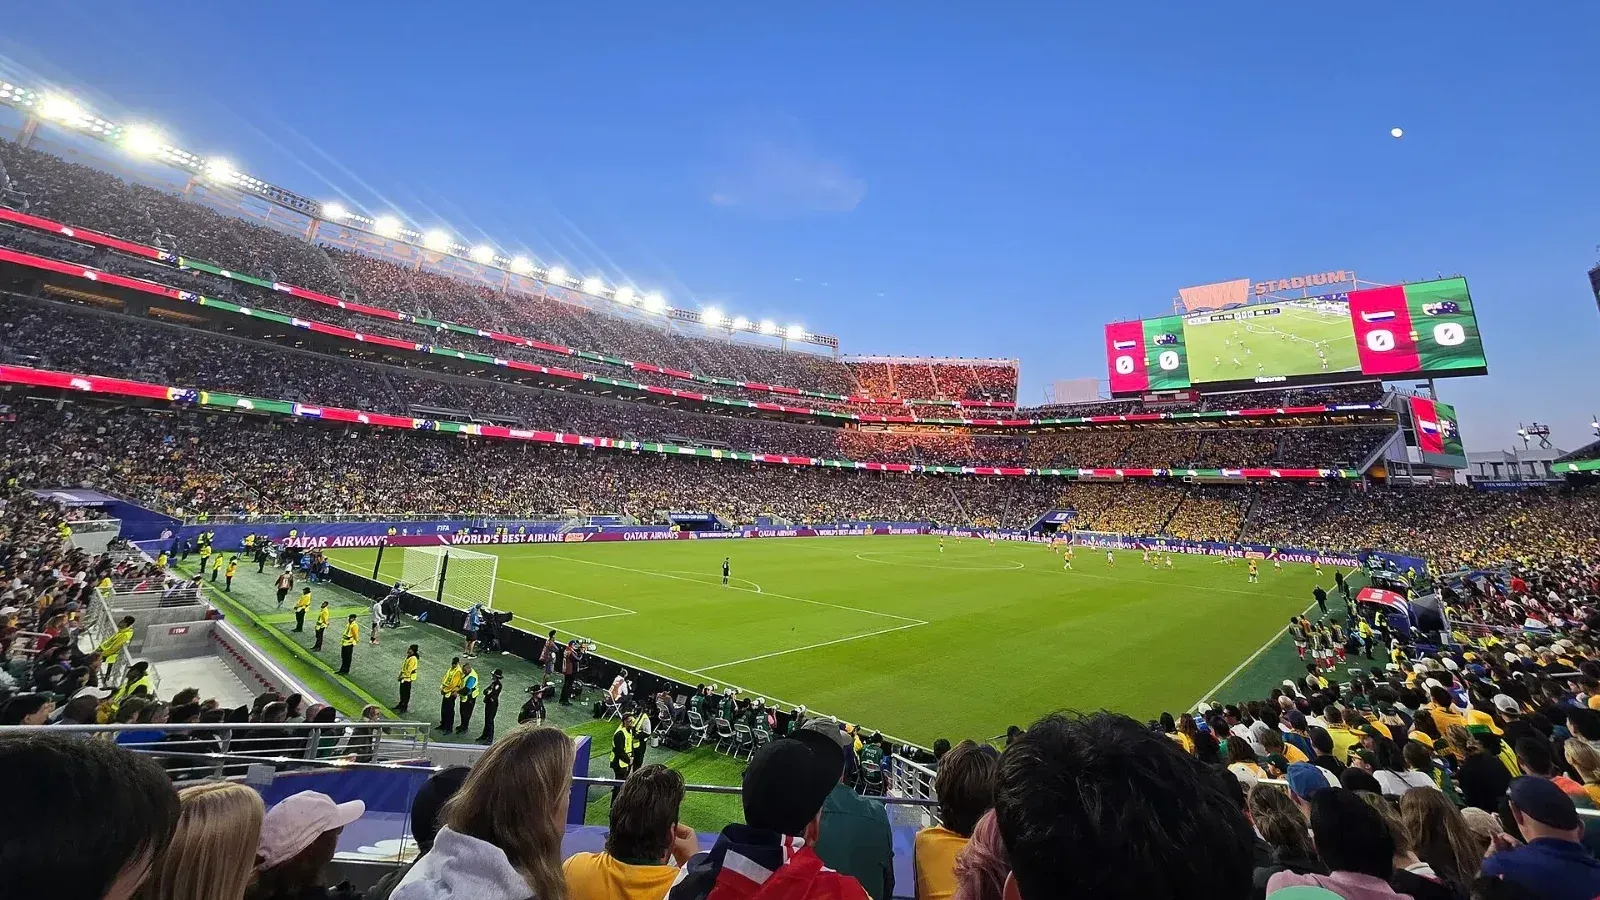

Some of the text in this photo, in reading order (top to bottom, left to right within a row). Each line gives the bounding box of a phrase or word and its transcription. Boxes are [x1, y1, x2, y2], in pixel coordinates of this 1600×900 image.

[1255, 270, 1346, 295] STADIUM
[451, 534, 500, 545] WORLD'S
[501, 533, 526, 544] BEST
[527, 532, 564, 542] AIRLINE
[624, 530, 679, 540] QATAR AIRWAYS
[758, 529, 798, 538] QATAR AIRWAYS
[983, 532, 1009, 540] WORLD'S
[1028, 535, 1053, 543] AIRLINE
[333, 535, 387, 546] AIRWAYS
[1149, 544, 1185, 554] WORLD'S
[1187, 547, 1207, 555] BEST
[1279, 553, 1358, 566] QATAR AIRWAYS
